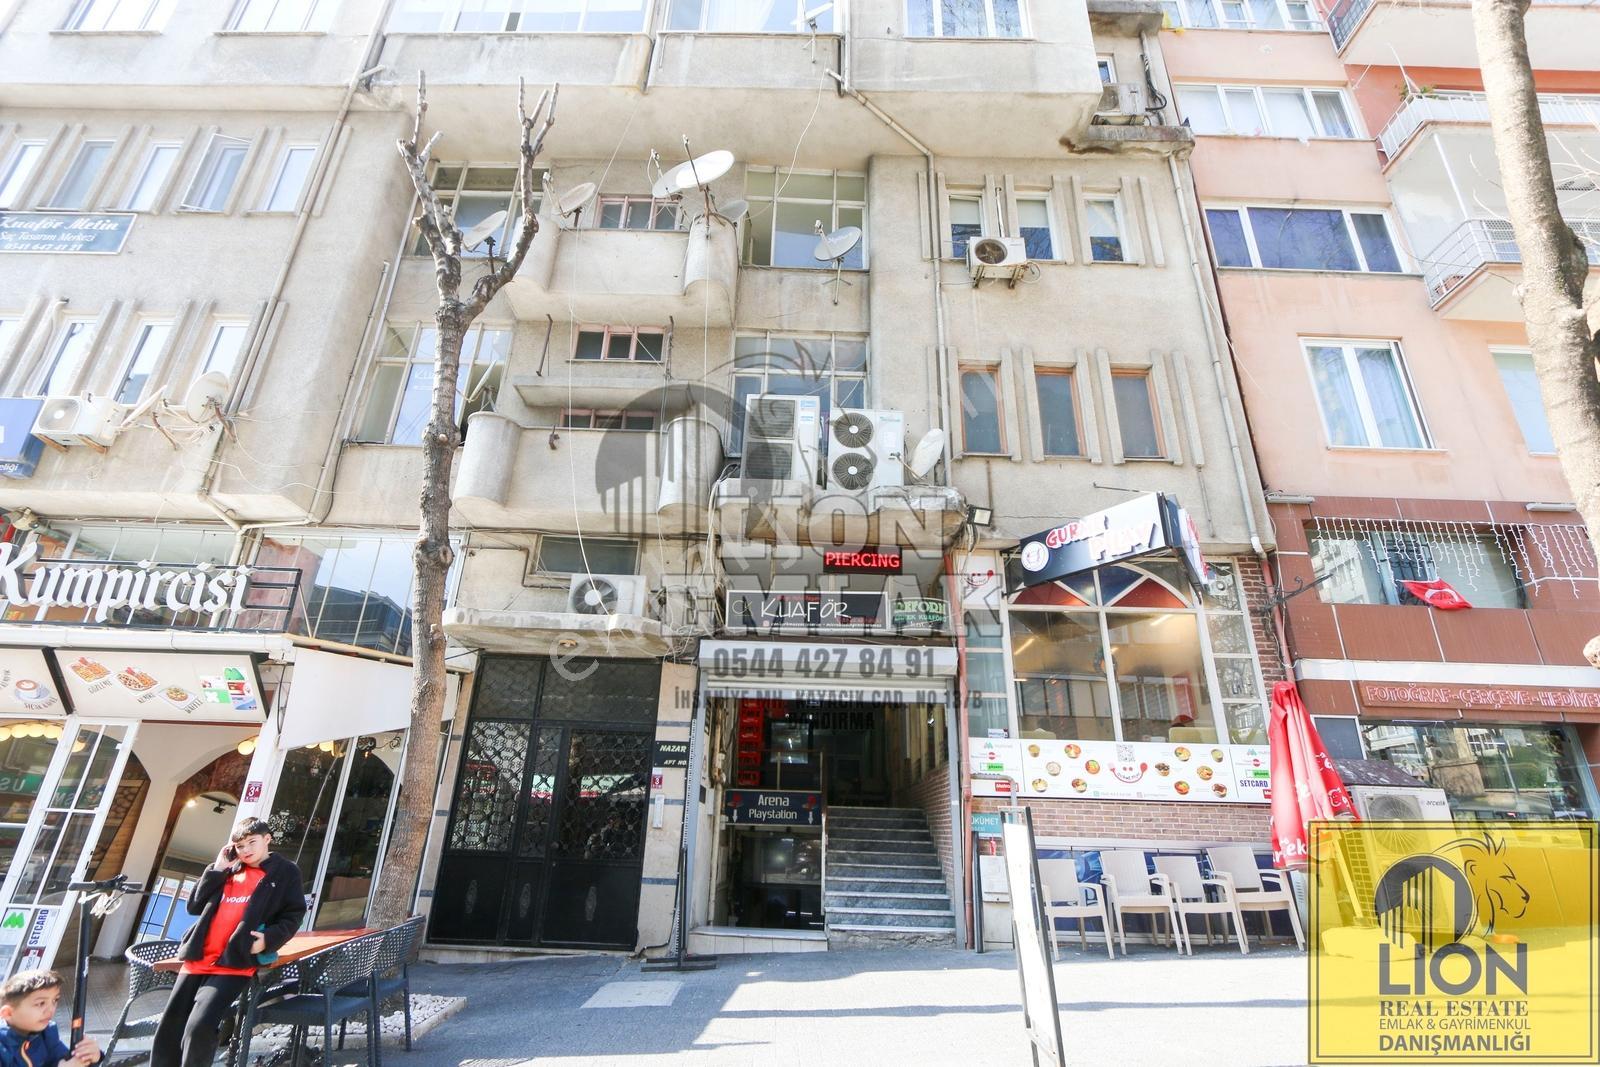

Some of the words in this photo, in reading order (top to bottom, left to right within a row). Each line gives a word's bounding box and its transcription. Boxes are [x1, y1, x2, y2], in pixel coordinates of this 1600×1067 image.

[64, 218, 119, 231] Metin
[60, 233, 97, 242] Merkezi
[825, 551, 900, 568] PIERCING
[761, 598, 851, 622] KUAFÖR
[660, 744, 687, 753] NAZAR
[1240, 779, 1269, 788] SETCARD
[757, 794, 790, 807] Arena
[748, 808, 798, 821] Playstation
[29, 909, 49, 945] SETCARD
